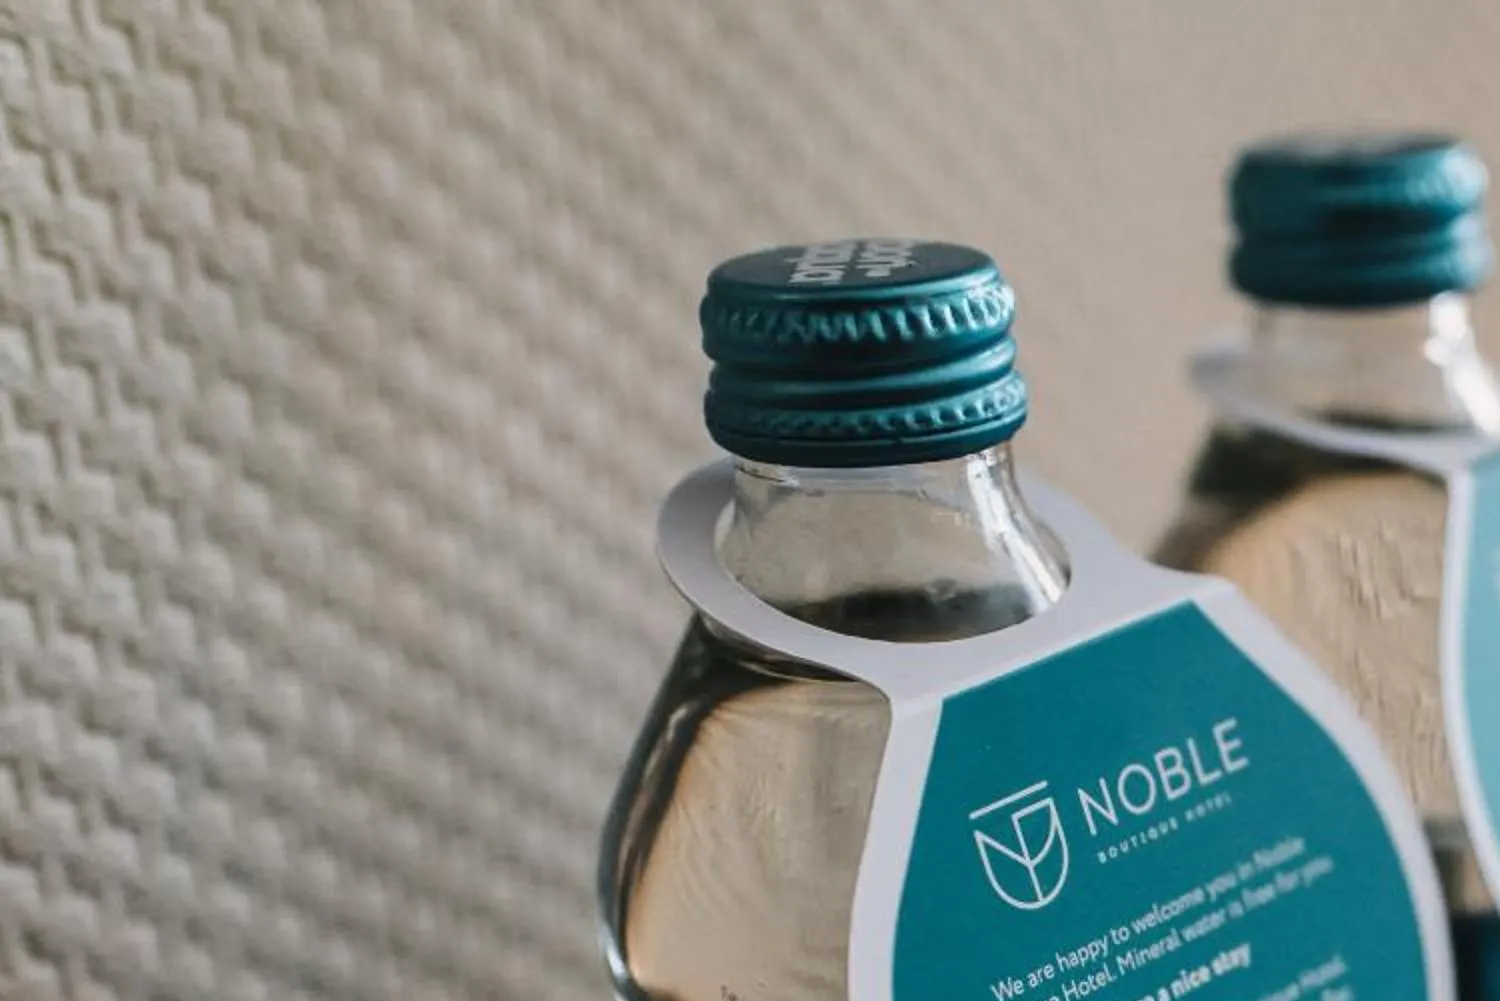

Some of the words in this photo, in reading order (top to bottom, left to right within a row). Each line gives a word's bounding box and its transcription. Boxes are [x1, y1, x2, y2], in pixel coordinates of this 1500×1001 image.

[1077, 717, 1250, 837] NOBLE
[1098, 816, 1178, 864] BOUTIQUE
[1027, 963, 1055, 988] are
[1055, 935, 1108, 972] happy
[1109, 926, 1130, 945] to
[1131, 886, 1204, 935] welcome
[1116, 927, 1182, 975] Mineral
[1181, 908, 1225, 943] water
[1170, 965, 1211, 998] nice
[1211, 943, 1251, 976] stay
